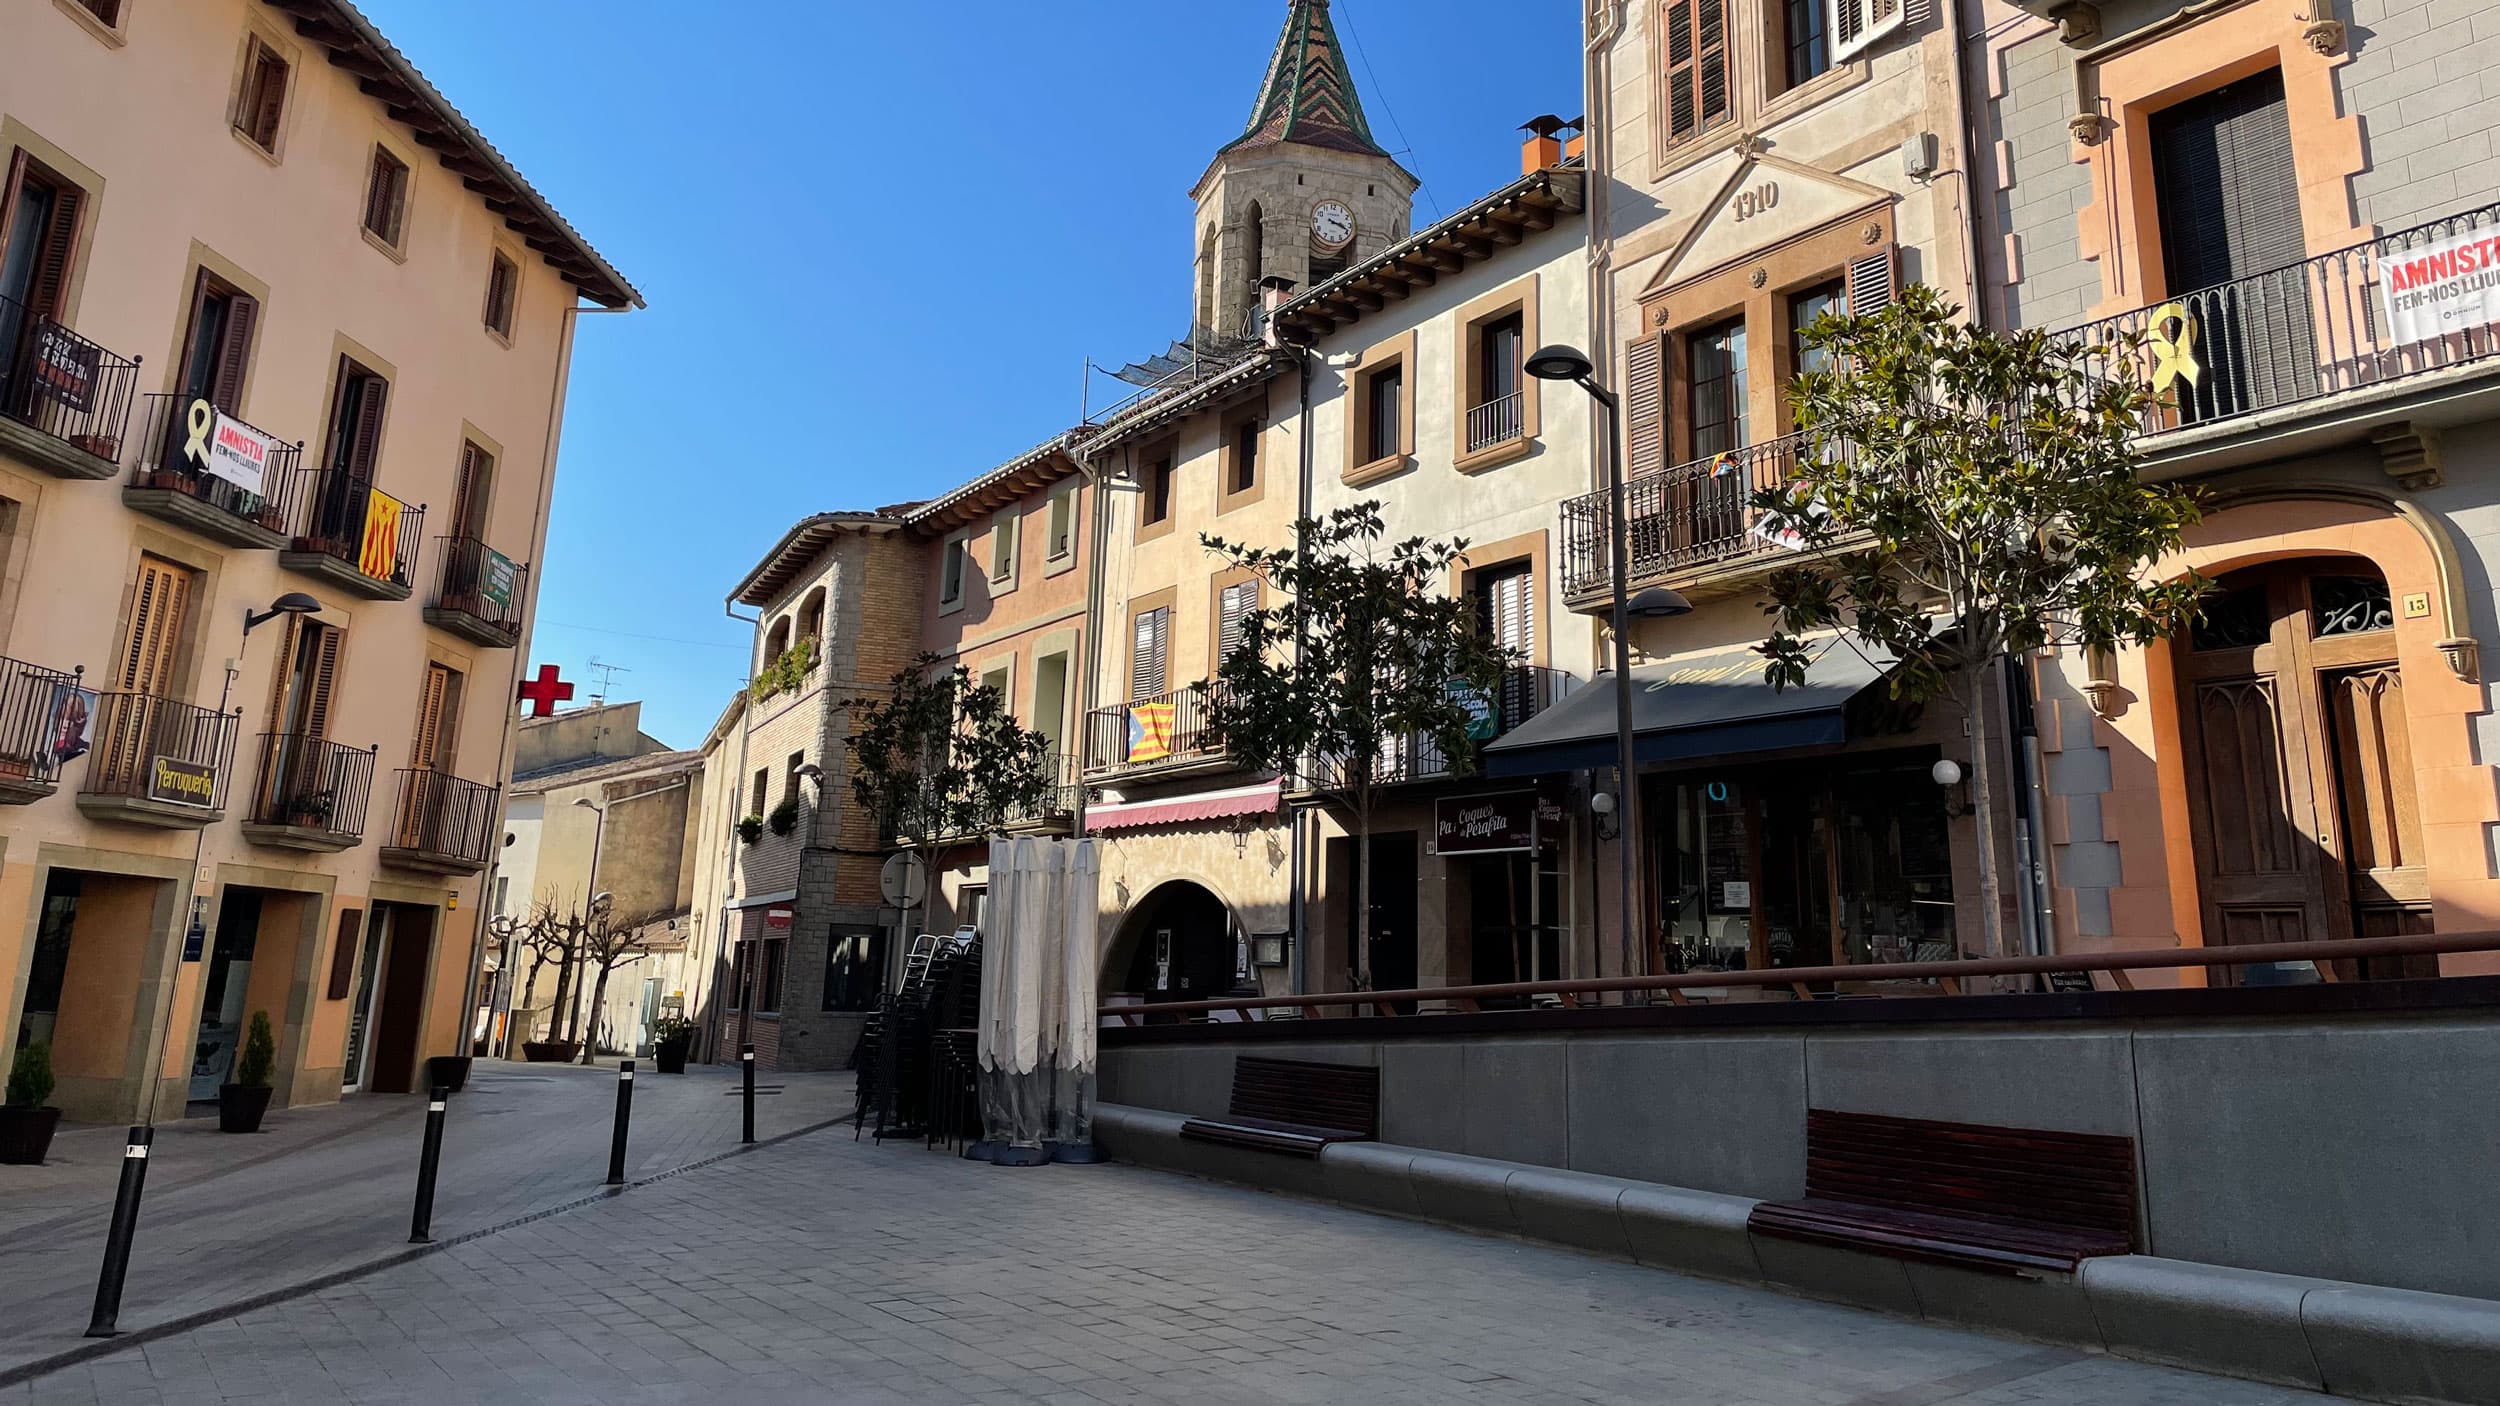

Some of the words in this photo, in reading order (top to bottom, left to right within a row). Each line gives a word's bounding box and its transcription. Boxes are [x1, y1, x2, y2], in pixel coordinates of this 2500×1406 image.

[1732, 181, 1779, 223] 1910
[2394, 281, 2460, 313] FEM-NOS
[215, 443, 240, 464] FEM-NOS
[218, 424, 264, 463] AMNISTIA
[2409, 599, 2426, 611] 13
[157, 759, 212, 803] Perruqueria
[1459, 803, 1494, 825] Coques
[1439, 820, 1452, 836] Pa
[1465, 815, 1507, 838] Perafita
